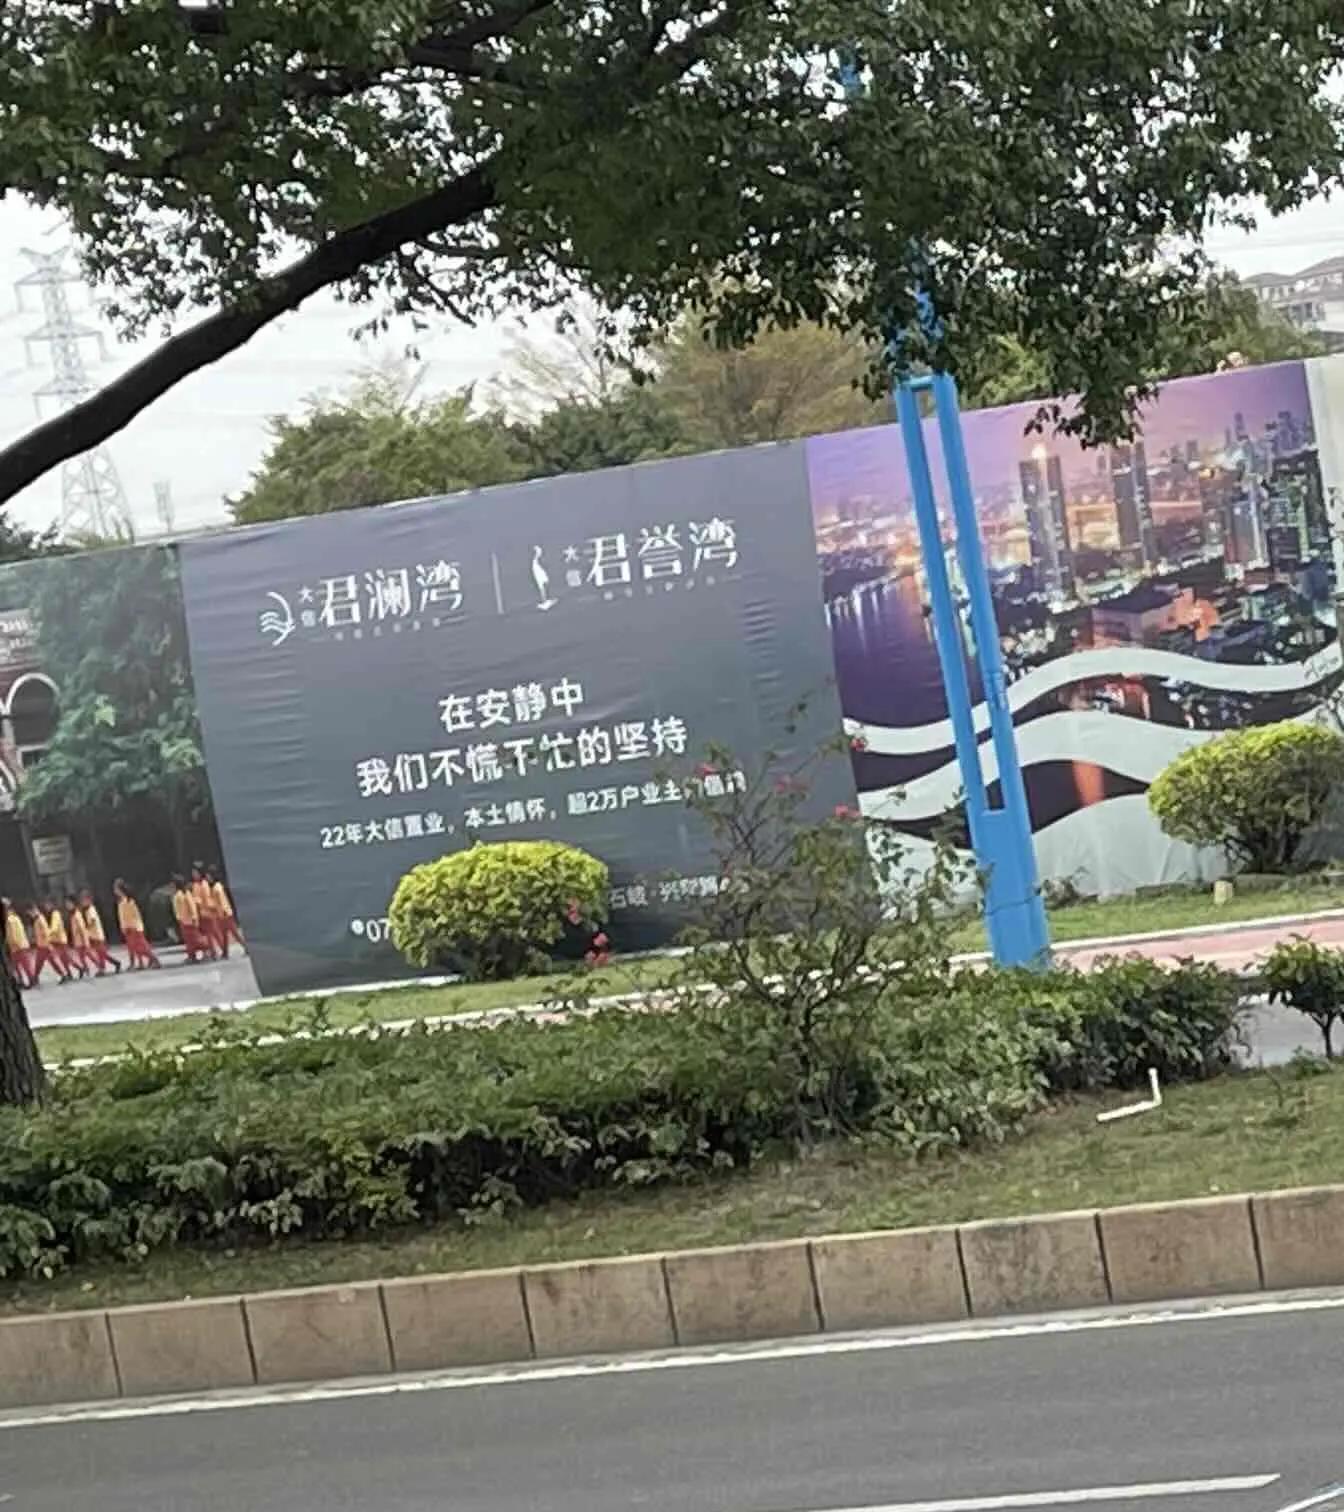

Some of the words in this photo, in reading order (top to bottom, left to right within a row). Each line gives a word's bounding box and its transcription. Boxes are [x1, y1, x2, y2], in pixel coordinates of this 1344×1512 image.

[438, 677, 584, 733] 在安静中
[355, 715, 688, 798] 我们不慌不忙的坚持
